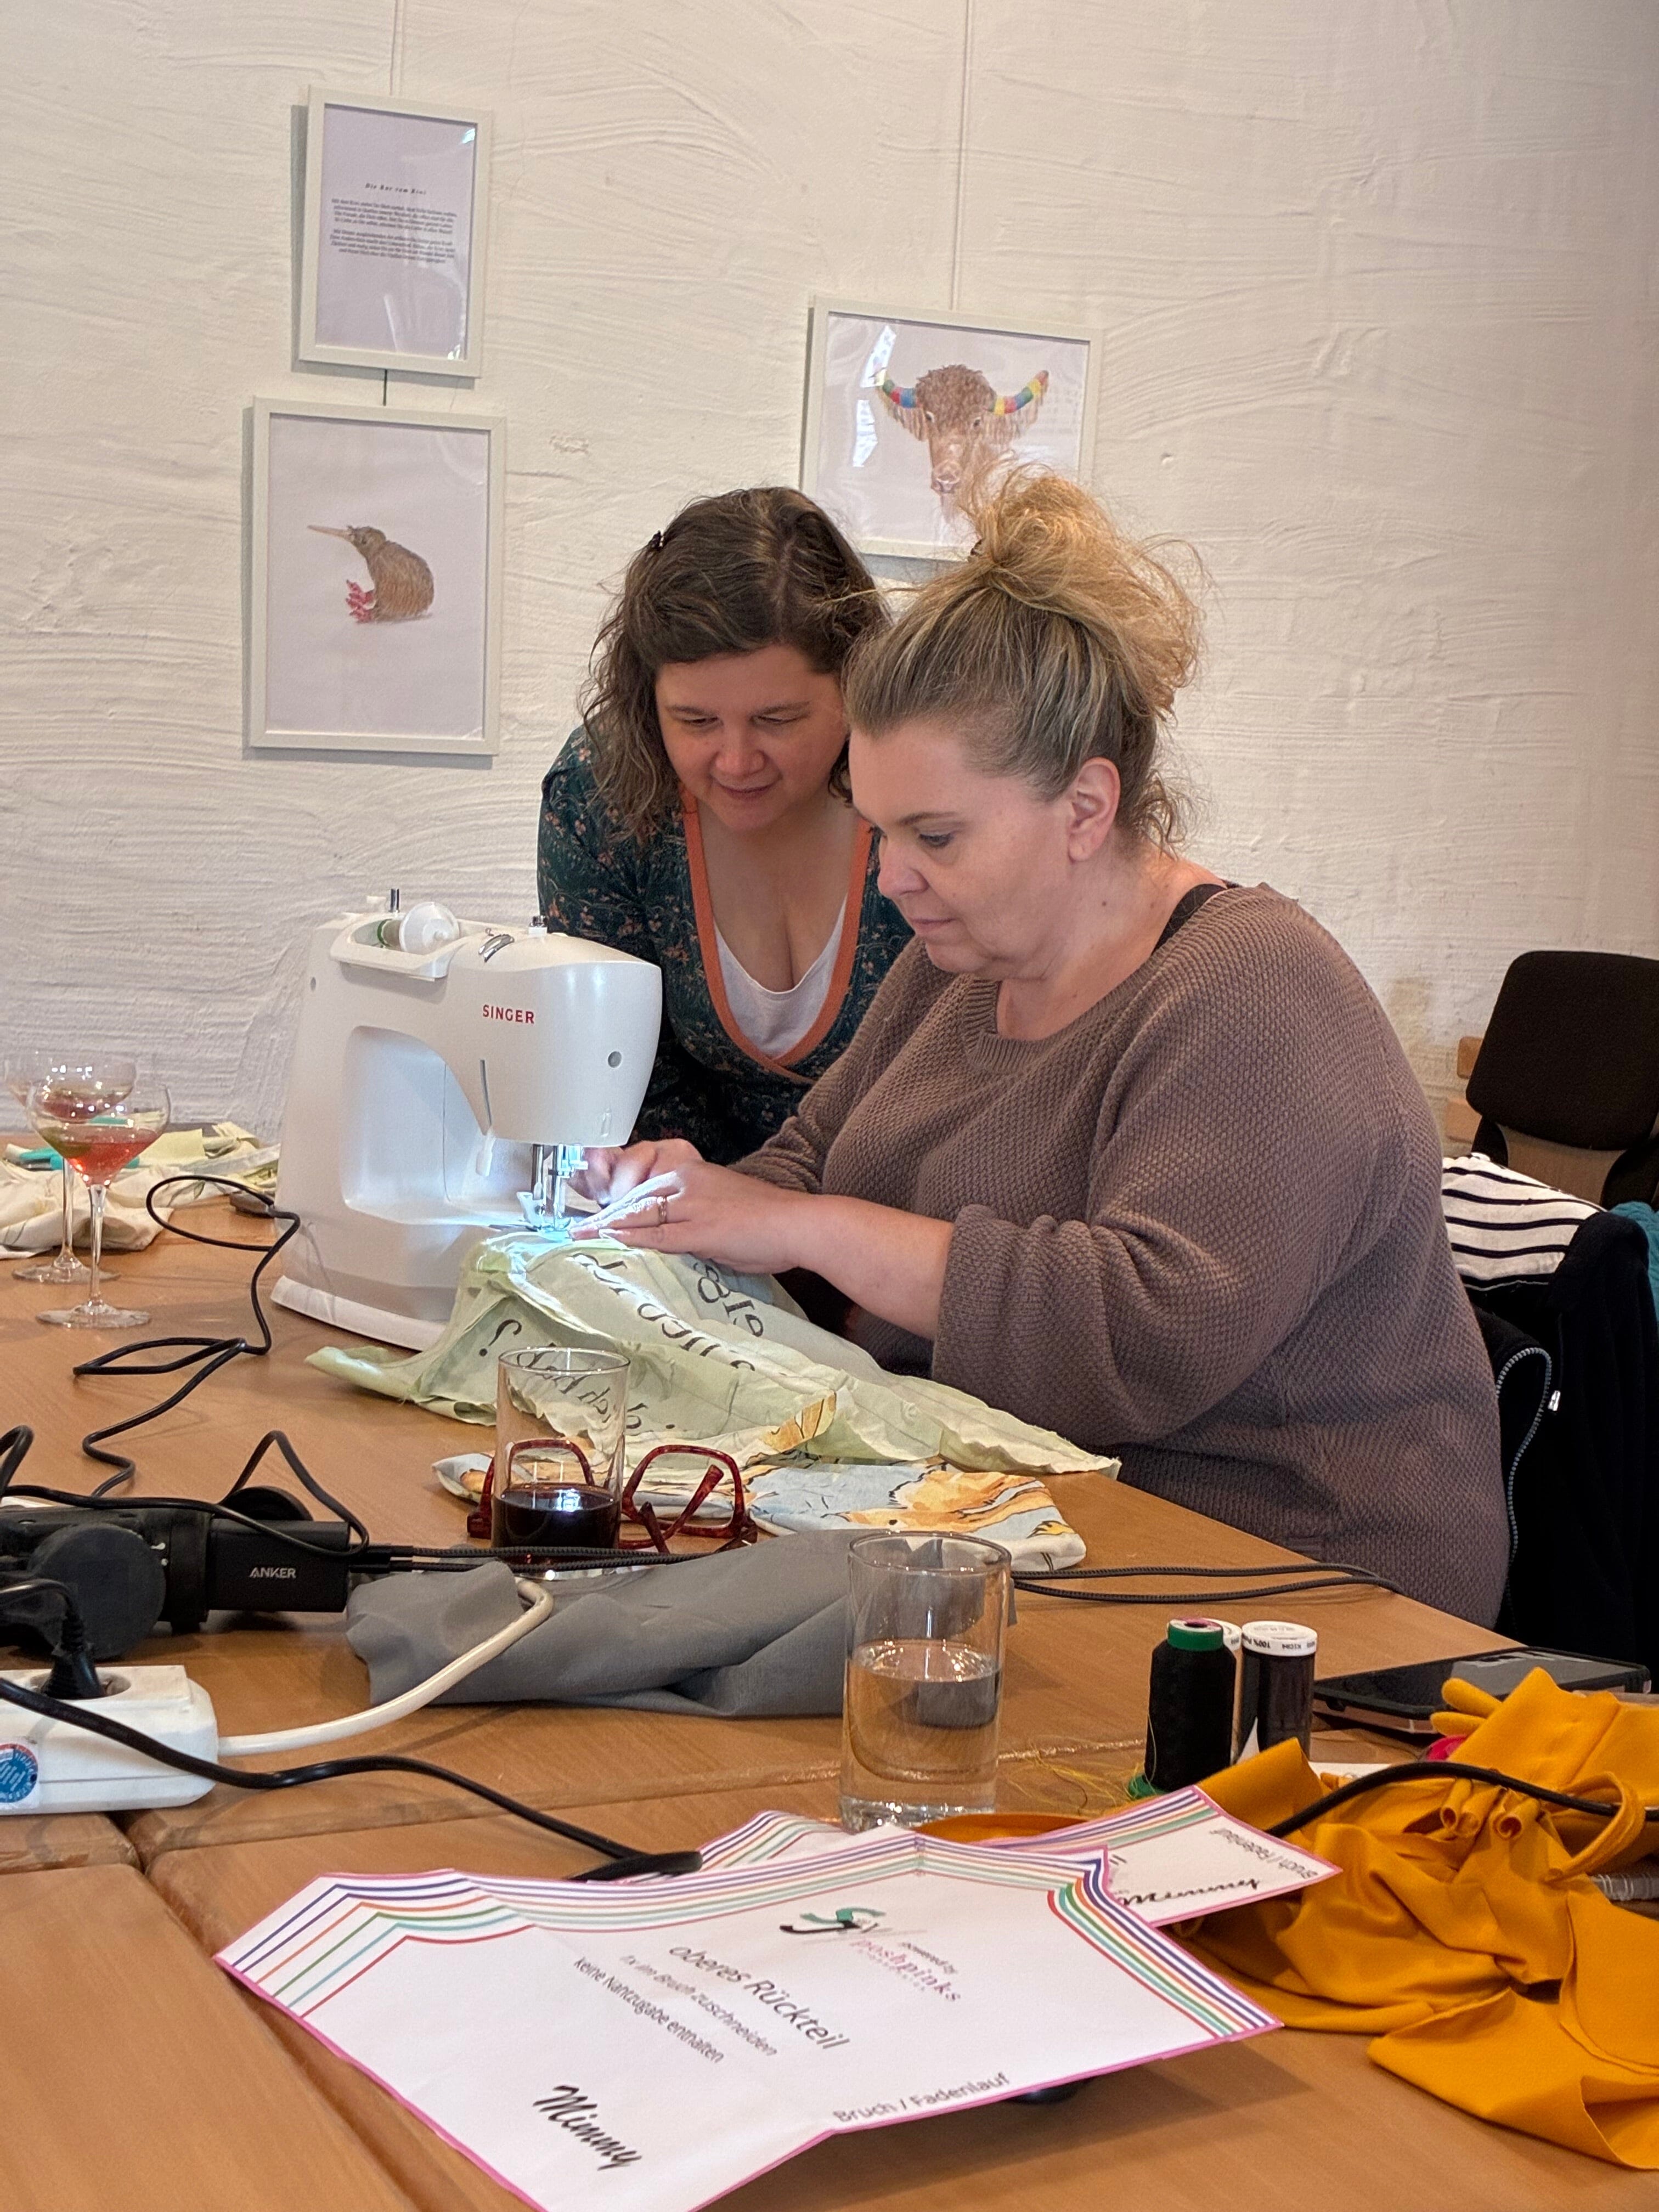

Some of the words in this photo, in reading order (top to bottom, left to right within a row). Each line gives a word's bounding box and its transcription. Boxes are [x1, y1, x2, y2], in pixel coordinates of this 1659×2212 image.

[482, 1004, 535, 1024] SINGER
[249, 1566, 297, 1579] ANKER
[669, 1946, 752, 1983] oberes
[743, 1979, 850, 2050] Rückteil
[833, 2102, 898, 2123] Bruch
[909, 2071, 1010, 2107] Fadenlauf
